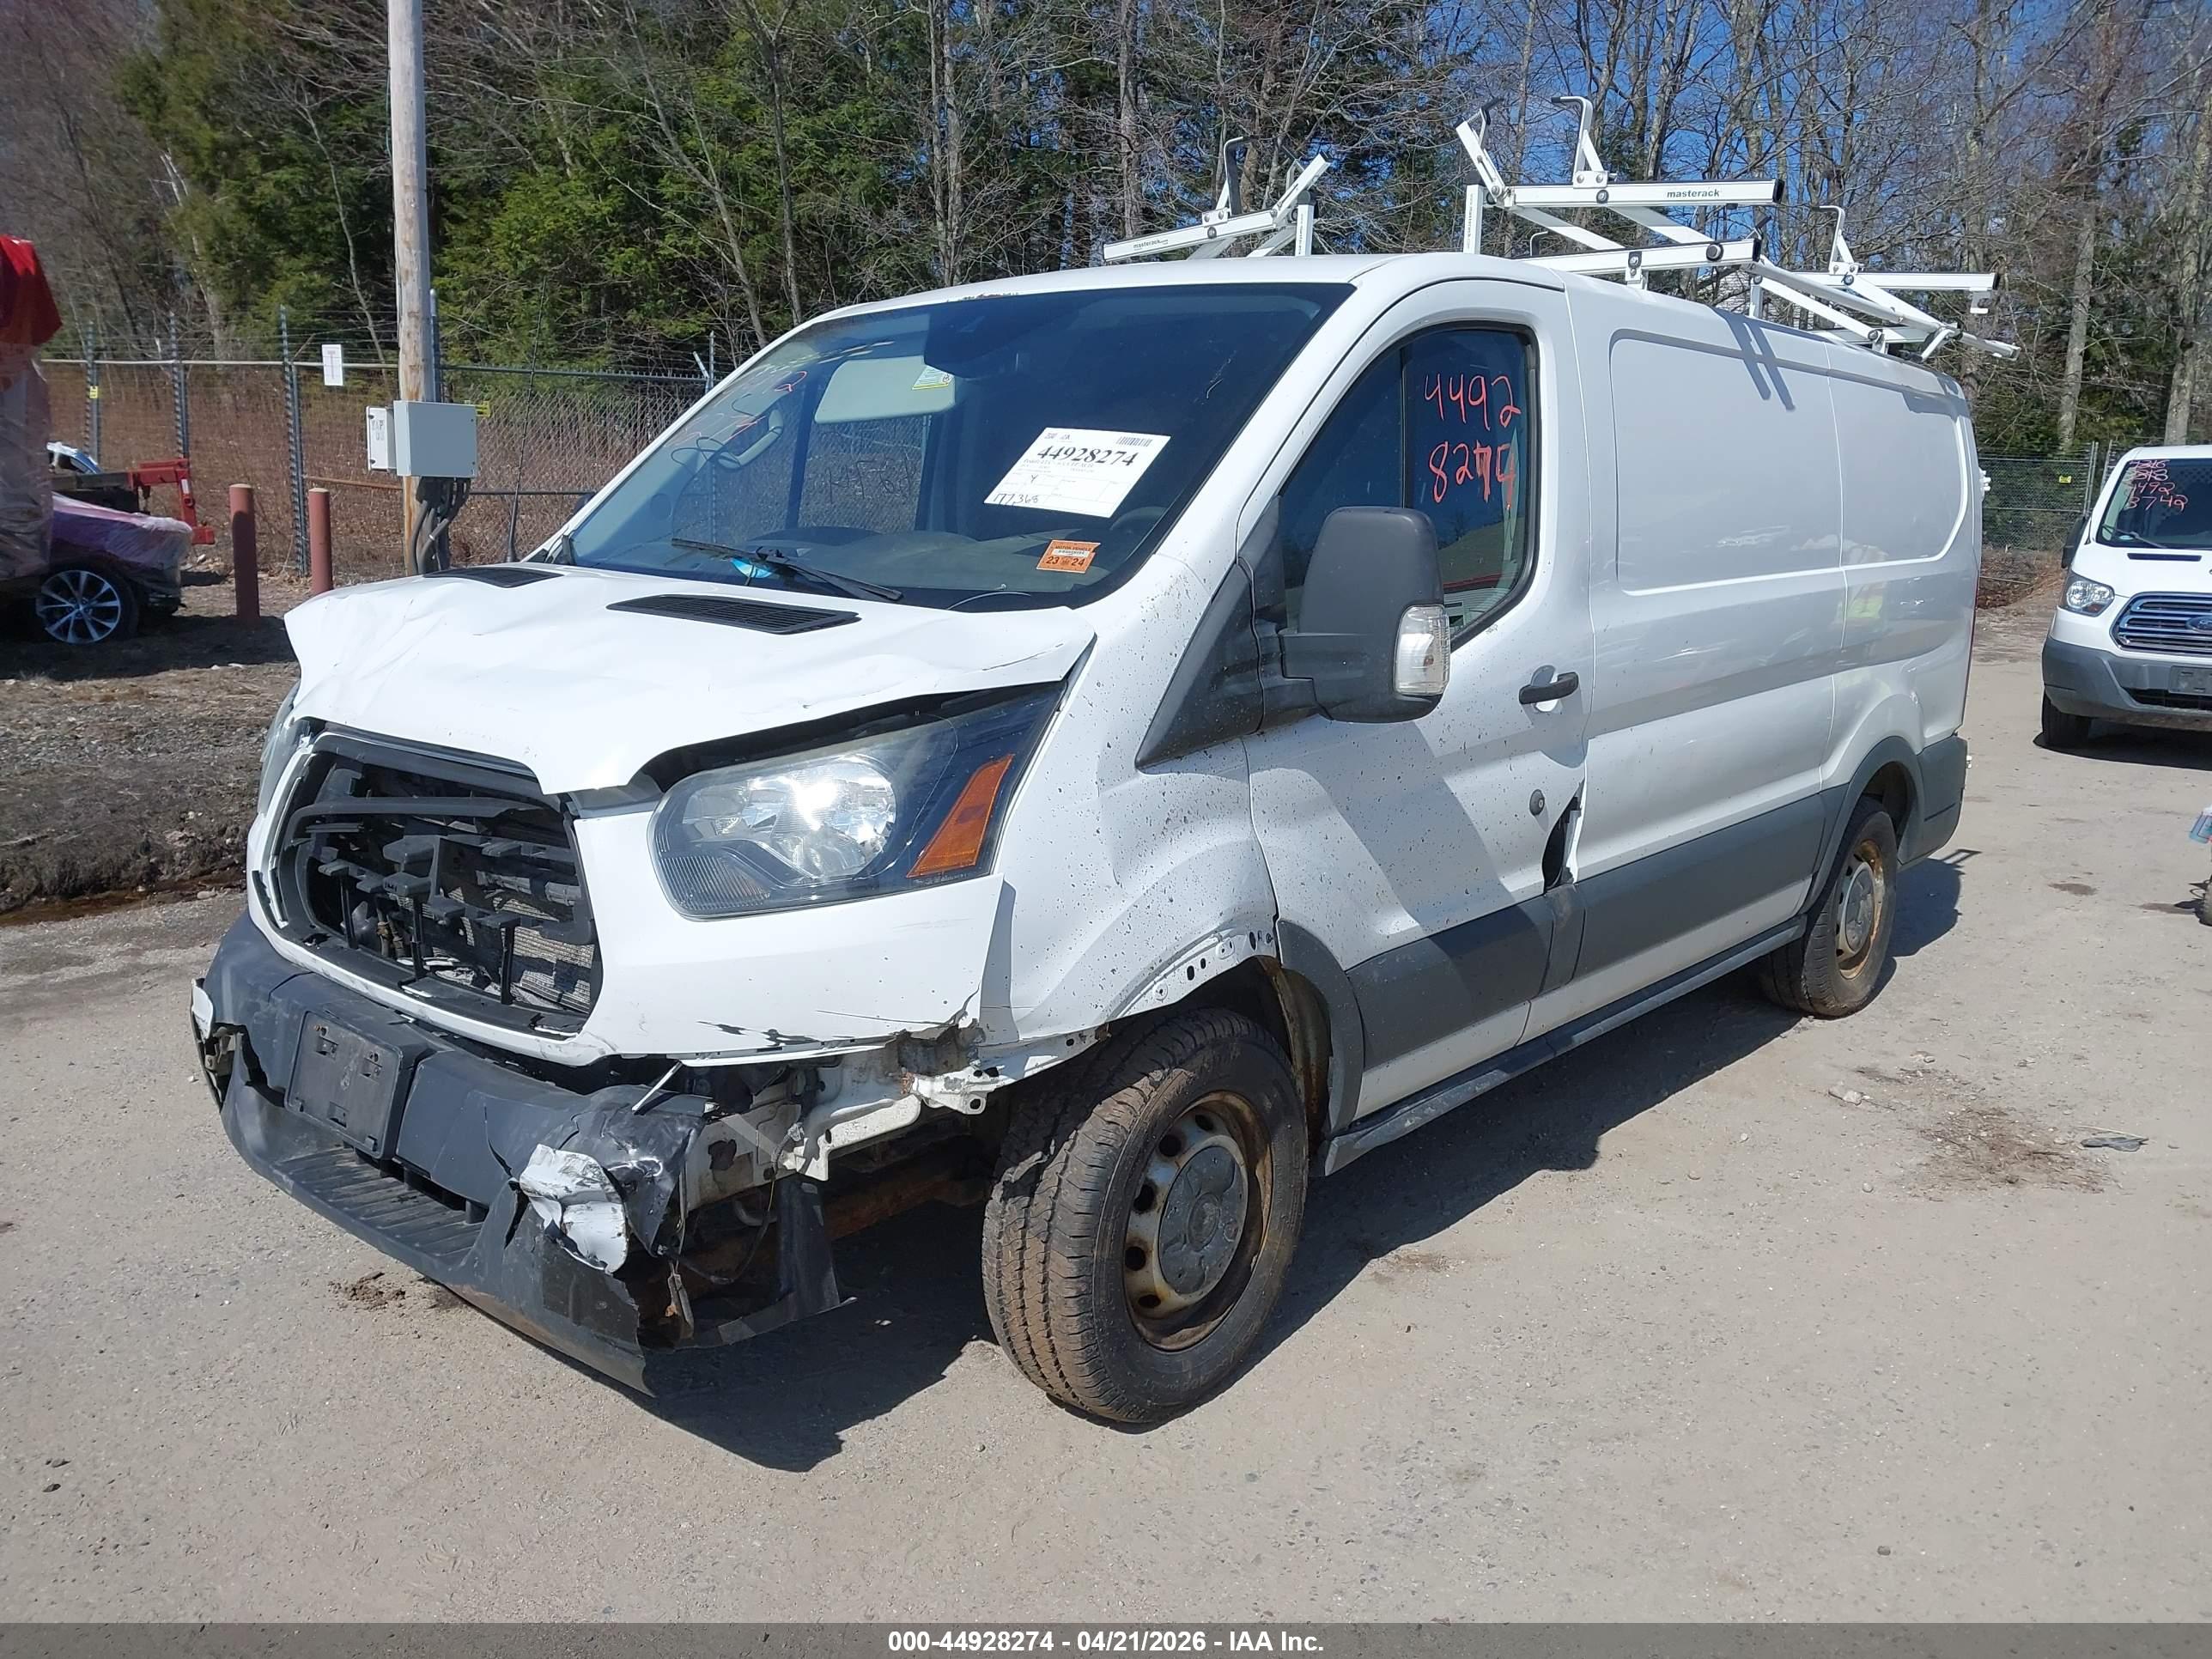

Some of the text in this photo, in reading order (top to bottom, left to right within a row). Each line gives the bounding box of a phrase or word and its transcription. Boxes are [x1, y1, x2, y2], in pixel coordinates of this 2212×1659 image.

[1667, 188, 1720, 198] masterack
[1425, 374, 1522, 431] 4492
[1037, 446, 1139, 466] 44928274
[1046, 556, 1060, 565] 23
[1071, 557, 1085, 567] 24
